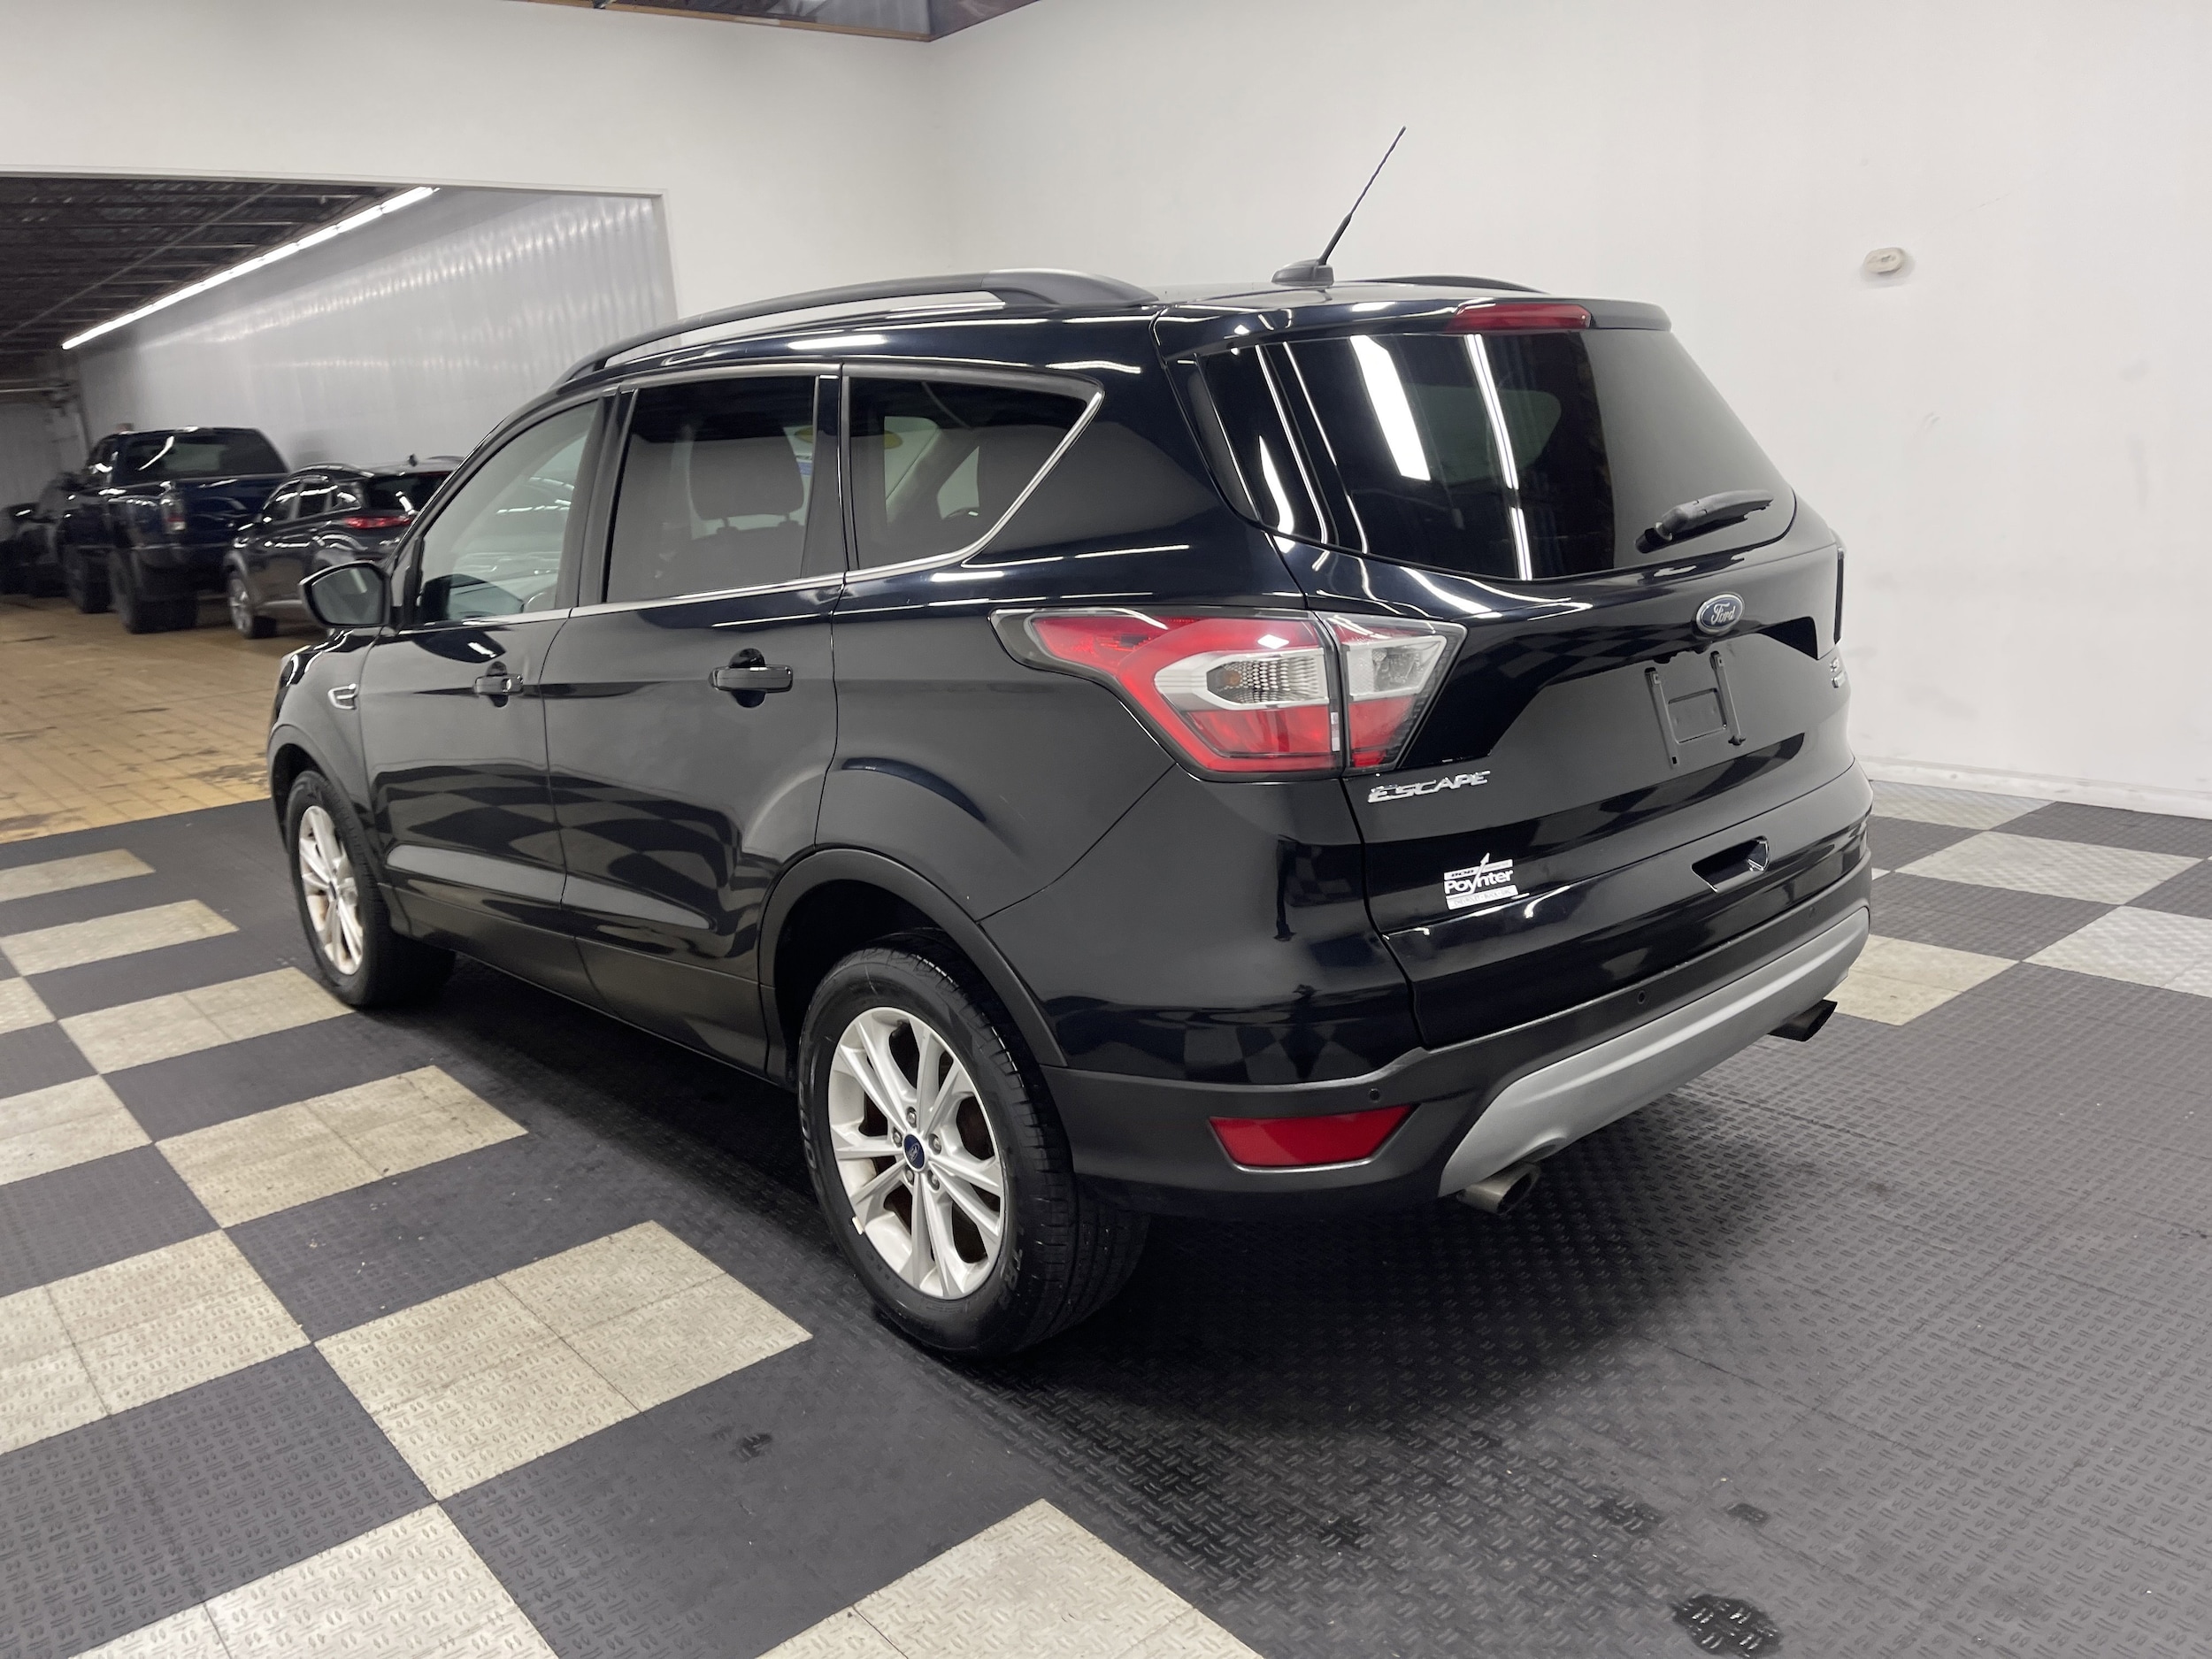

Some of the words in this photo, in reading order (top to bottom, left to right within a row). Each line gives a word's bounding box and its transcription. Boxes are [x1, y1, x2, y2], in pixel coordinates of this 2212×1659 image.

[1710, 602, 1736, 625] Ford
[1368, 771, 1491, 803] ESCAPE
[1444, 870, 1514, 895] Poynter
